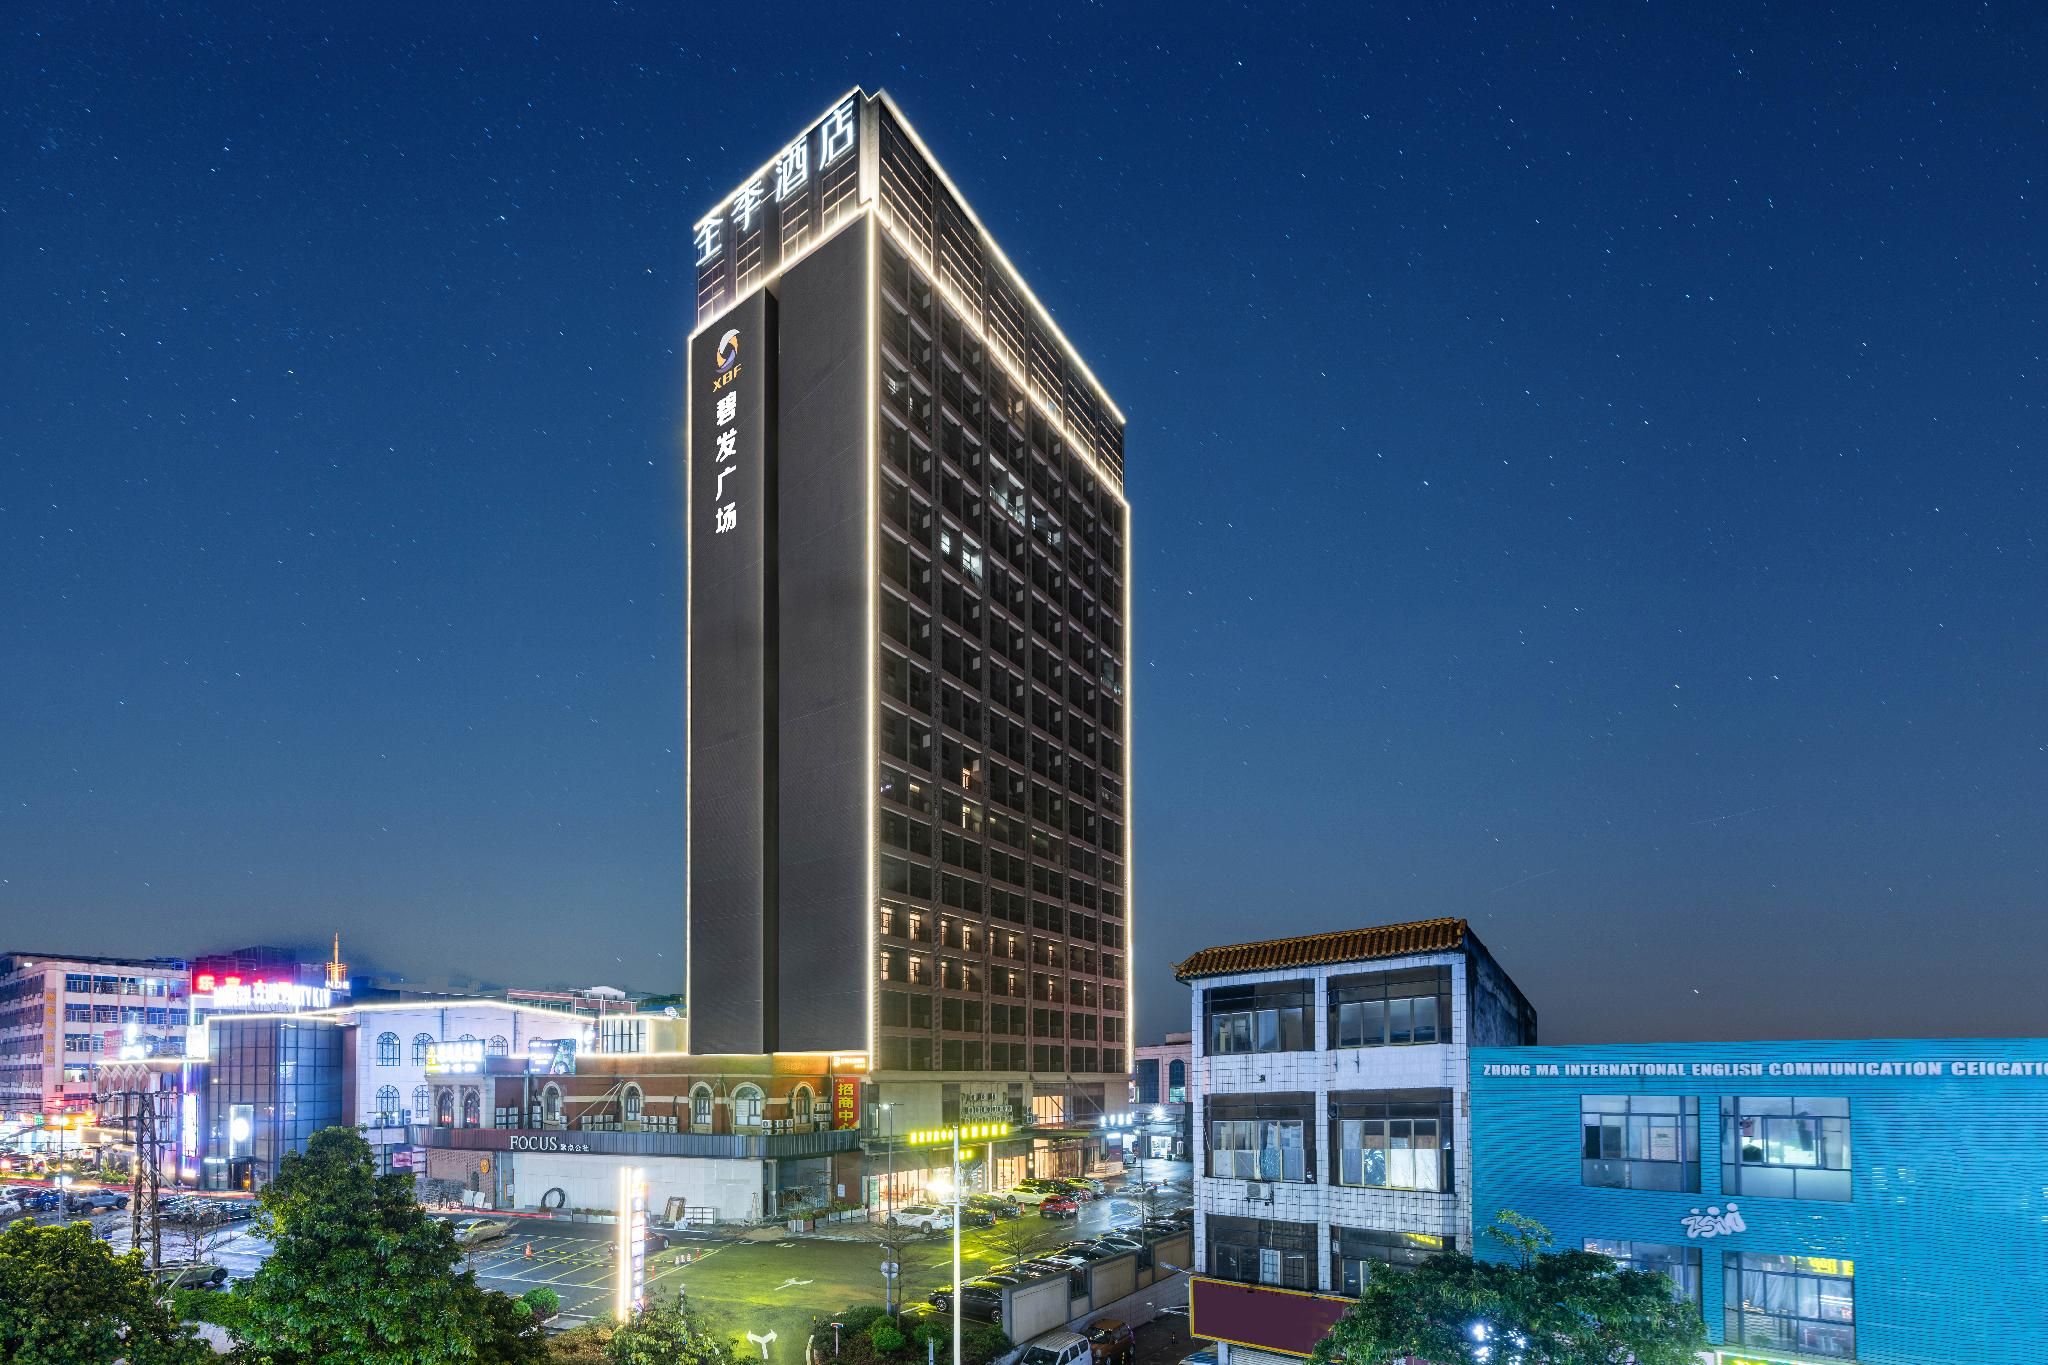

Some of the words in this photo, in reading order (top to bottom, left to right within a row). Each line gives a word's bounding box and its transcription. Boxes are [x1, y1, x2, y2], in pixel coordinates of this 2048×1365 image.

[693, 100, 855, 267] 全季酒店
[712, 363, 743, 393] XBF
[1483, 1063, 1531, 1076] ZHONG
[1535, 1063, 1560, 1076] MA
[1565, 1063, 1686, 1076] INTERNATIONAL
[1691, 1063, 1763, 1076] ENGLISH
[1768, 1061, 1943, 1076] COMMUNICATION
[509, 1135, 558, 1151] FOCUS
